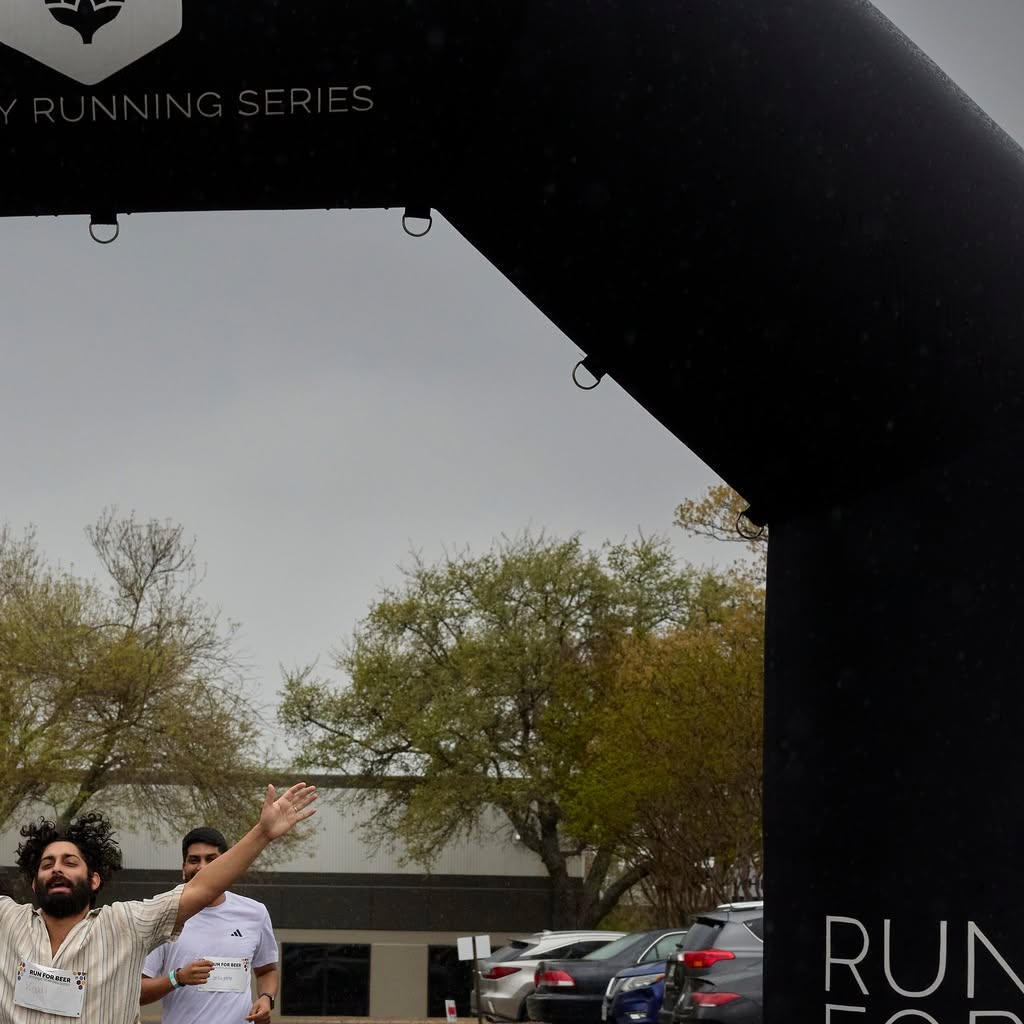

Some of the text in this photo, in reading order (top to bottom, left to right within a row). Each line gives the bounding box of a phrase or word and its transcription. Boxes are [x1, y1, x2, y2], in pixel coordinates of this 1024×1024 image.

[33, 91, 222, 124] RUNNING
[238, 85, 374, 116] SERIES
[825, 915, 1024, 999] RUN
